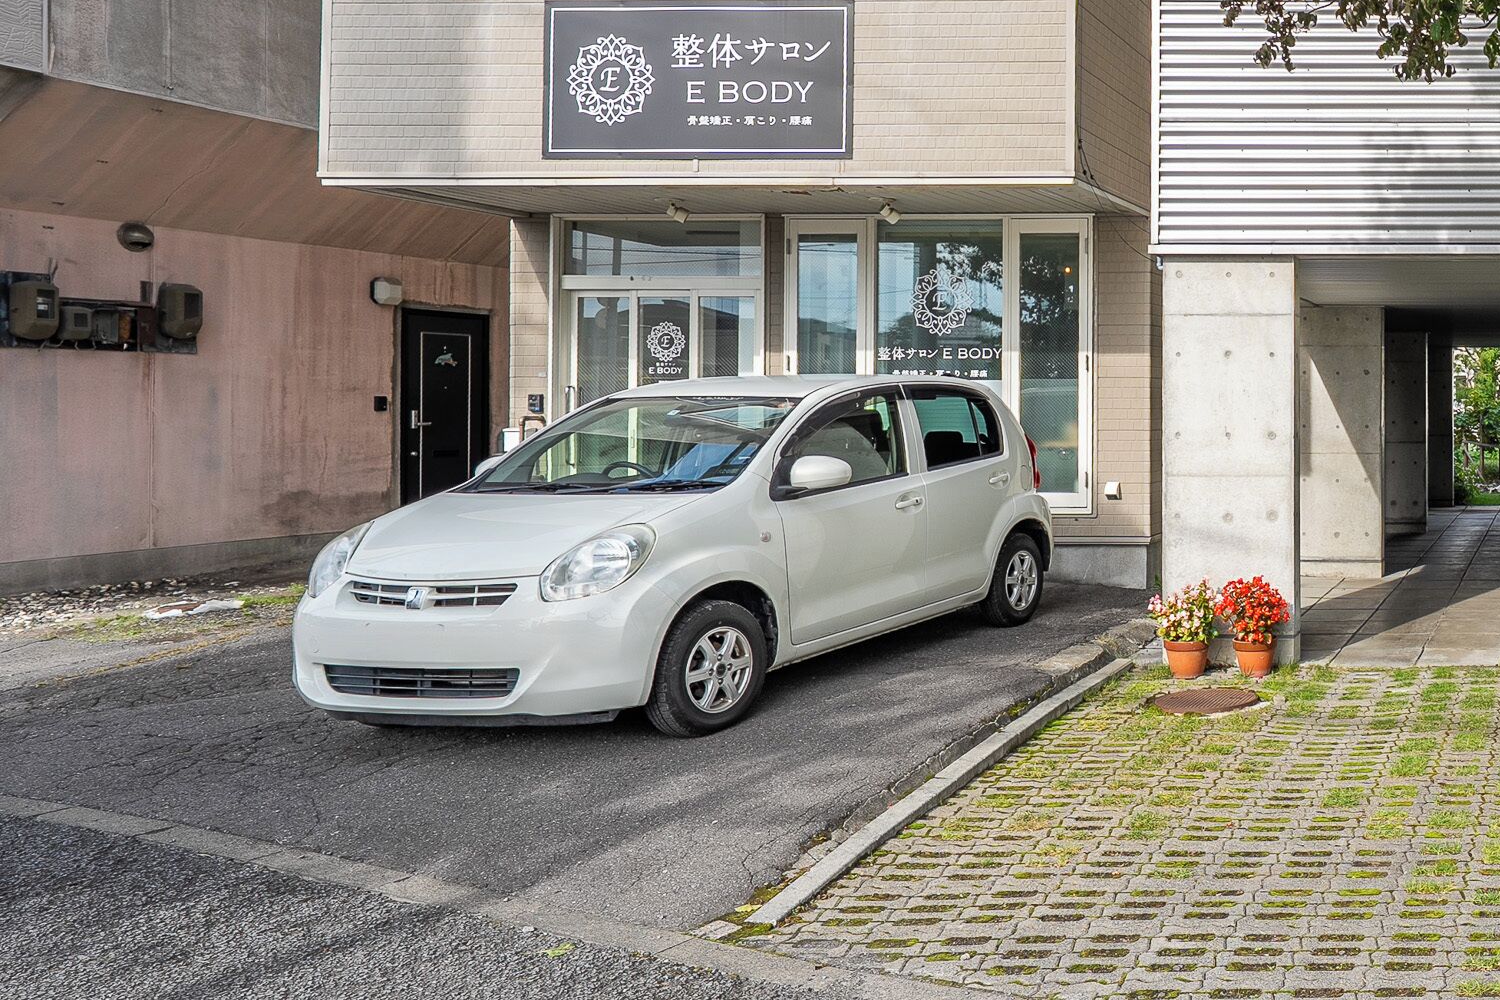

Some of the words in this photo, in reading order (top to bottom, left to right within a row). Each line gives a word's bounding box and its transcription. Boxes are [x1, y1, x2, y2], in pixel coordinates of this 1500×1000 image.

[671, 33, 831, 68] 整体サロン
[686, 80, 706, 104] E
[718, 80, 814, 104] BODY
[878, 346, 938, 361] 整体サロン
[943, 347, 953, 359] E
[958, 347, 1002, 359] BODY
[649, 366, 656, 374] E
[657, 366, 682, 374] BODY
